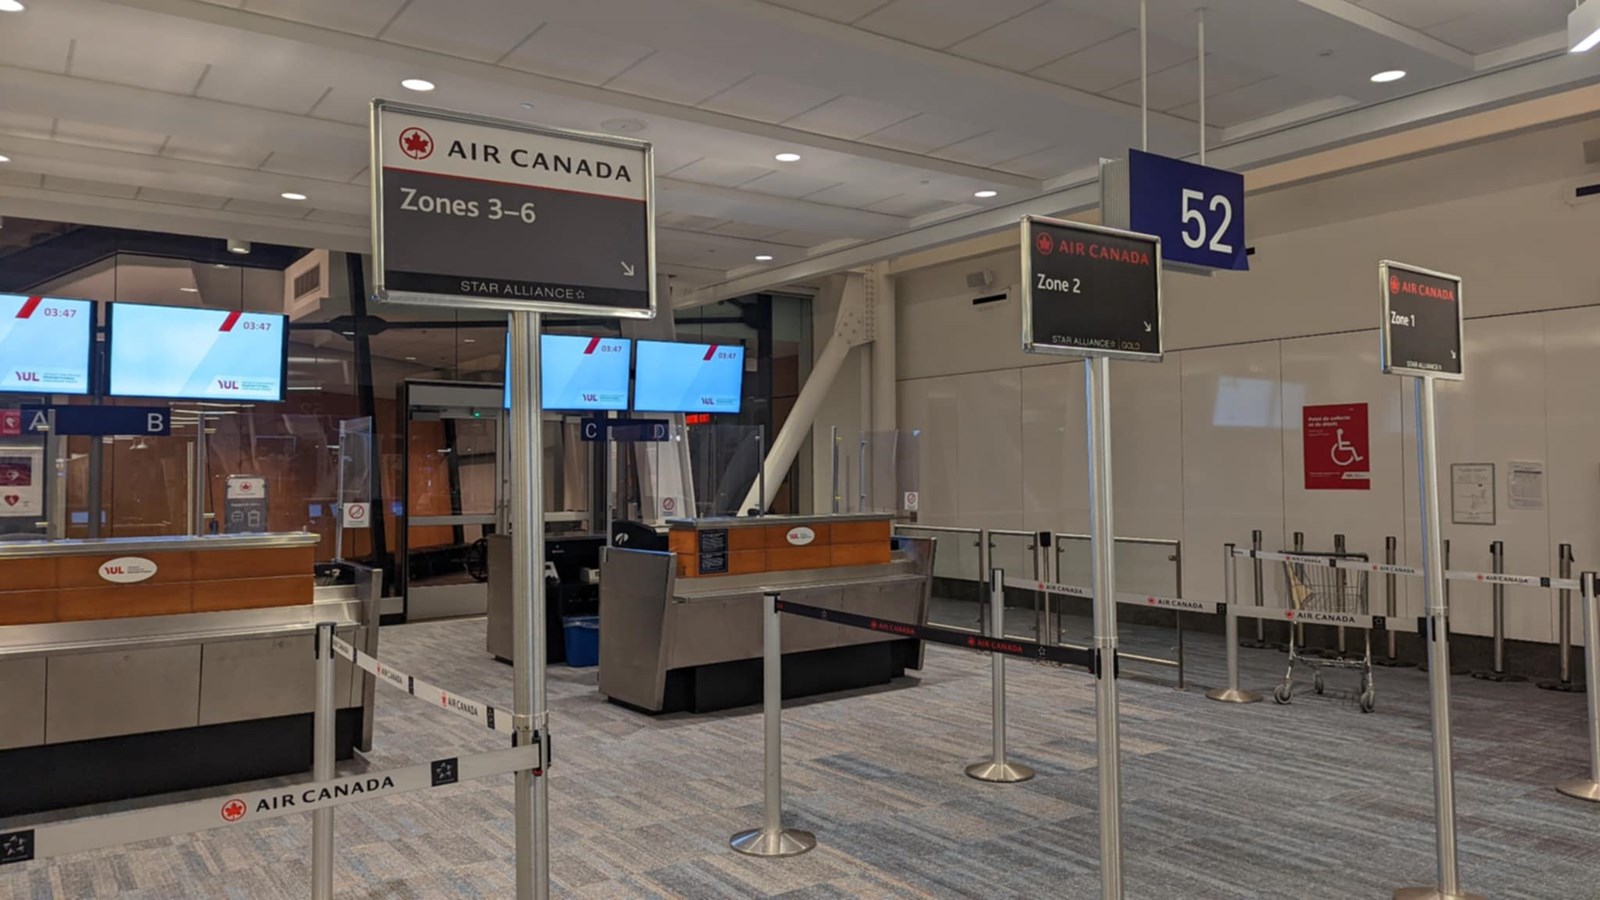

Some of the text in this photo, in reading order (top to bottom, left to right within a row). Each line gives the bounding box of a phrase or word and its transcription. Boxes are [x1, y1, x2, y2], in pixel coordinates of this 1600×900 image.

[448, 140, 632, 182] AIR CANADA
[400, 187, 480, 217] Zones
[1181, 188, 1233, 254] 52
[1058, 239, 1150, 266] AIR CANADA
[460, 280, 574, 299] STAR ALLIANCE
[1036, 273, 1081, 294] Zone 2
[1402, 281, 1455, 302] AIR CANADA
[44, 307, 77, 318] 03:47
[1390, 310, 1416, 327] Zone 1
[243, 321, 272, 331] 03:47
[601, 345, 623, 353] 03:47
[1052, 335, 1141, 350] STAR ALLIANCE GOLD
[718, 352, 737, 360] 03:47
[15, 371, 40, 382] YUL
[217, 380, 239, 390] YUL
[28, 411, 48, 431] A
[147, 413, 164, 432] B
[585, 422, 598, 438] C
[653, 423, 665, 439] D
[105, 566, 125, 575] YUL
[1057, 585, 1083, 594] CANADA
[1157, 598, 1203, 610] AIR CANADA
[1297, 612, 1356, 624] AIR CANADA
[977, 638, 1023, 653] AIR CANADA
[448, 697, 479, 717] AIR CANADA
[256, 776, 395, 813] AIR CANADA
